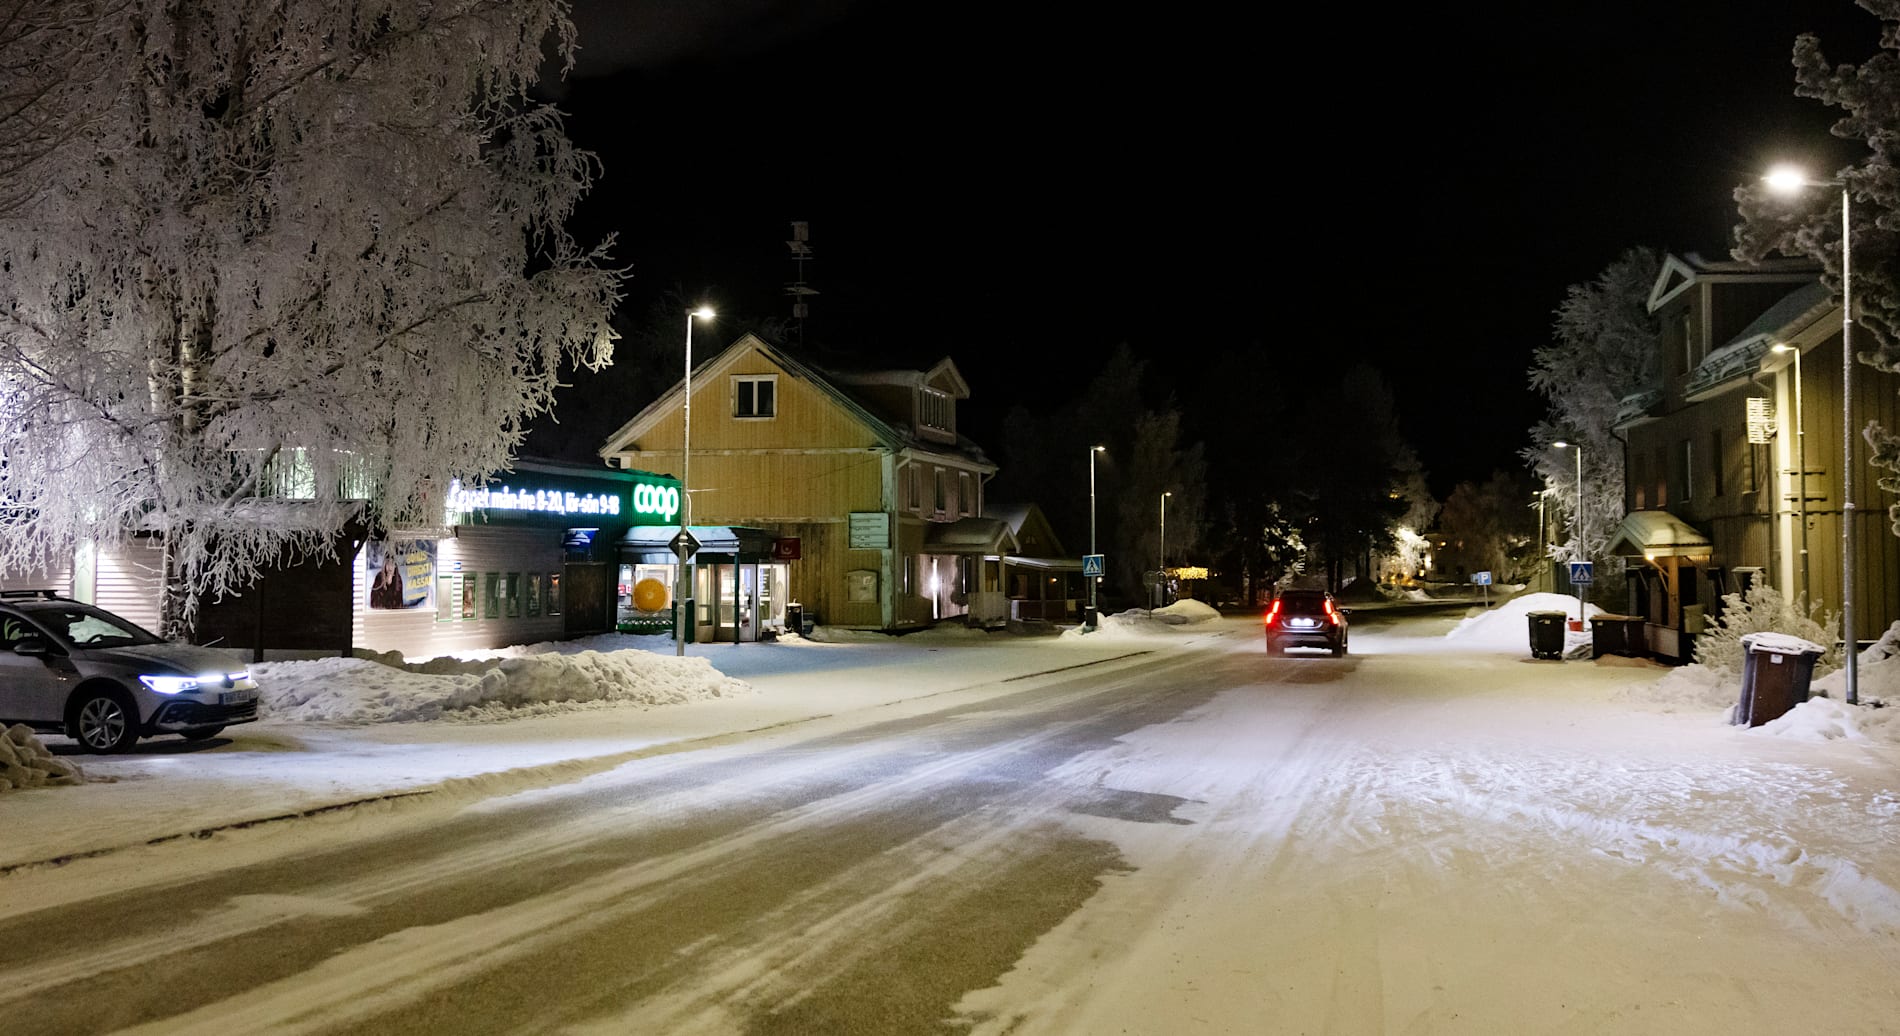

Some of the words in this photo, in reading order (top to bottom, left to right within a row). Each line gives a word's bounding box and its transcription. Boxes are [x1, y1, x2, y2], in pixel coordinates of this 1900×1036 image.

[491, 485, 535, 510] mån-fre
[537, 490, 565, 515] 8-20,
[566, 492, 599, 514] lör-sön
[634, 483, 679, 522] coop
